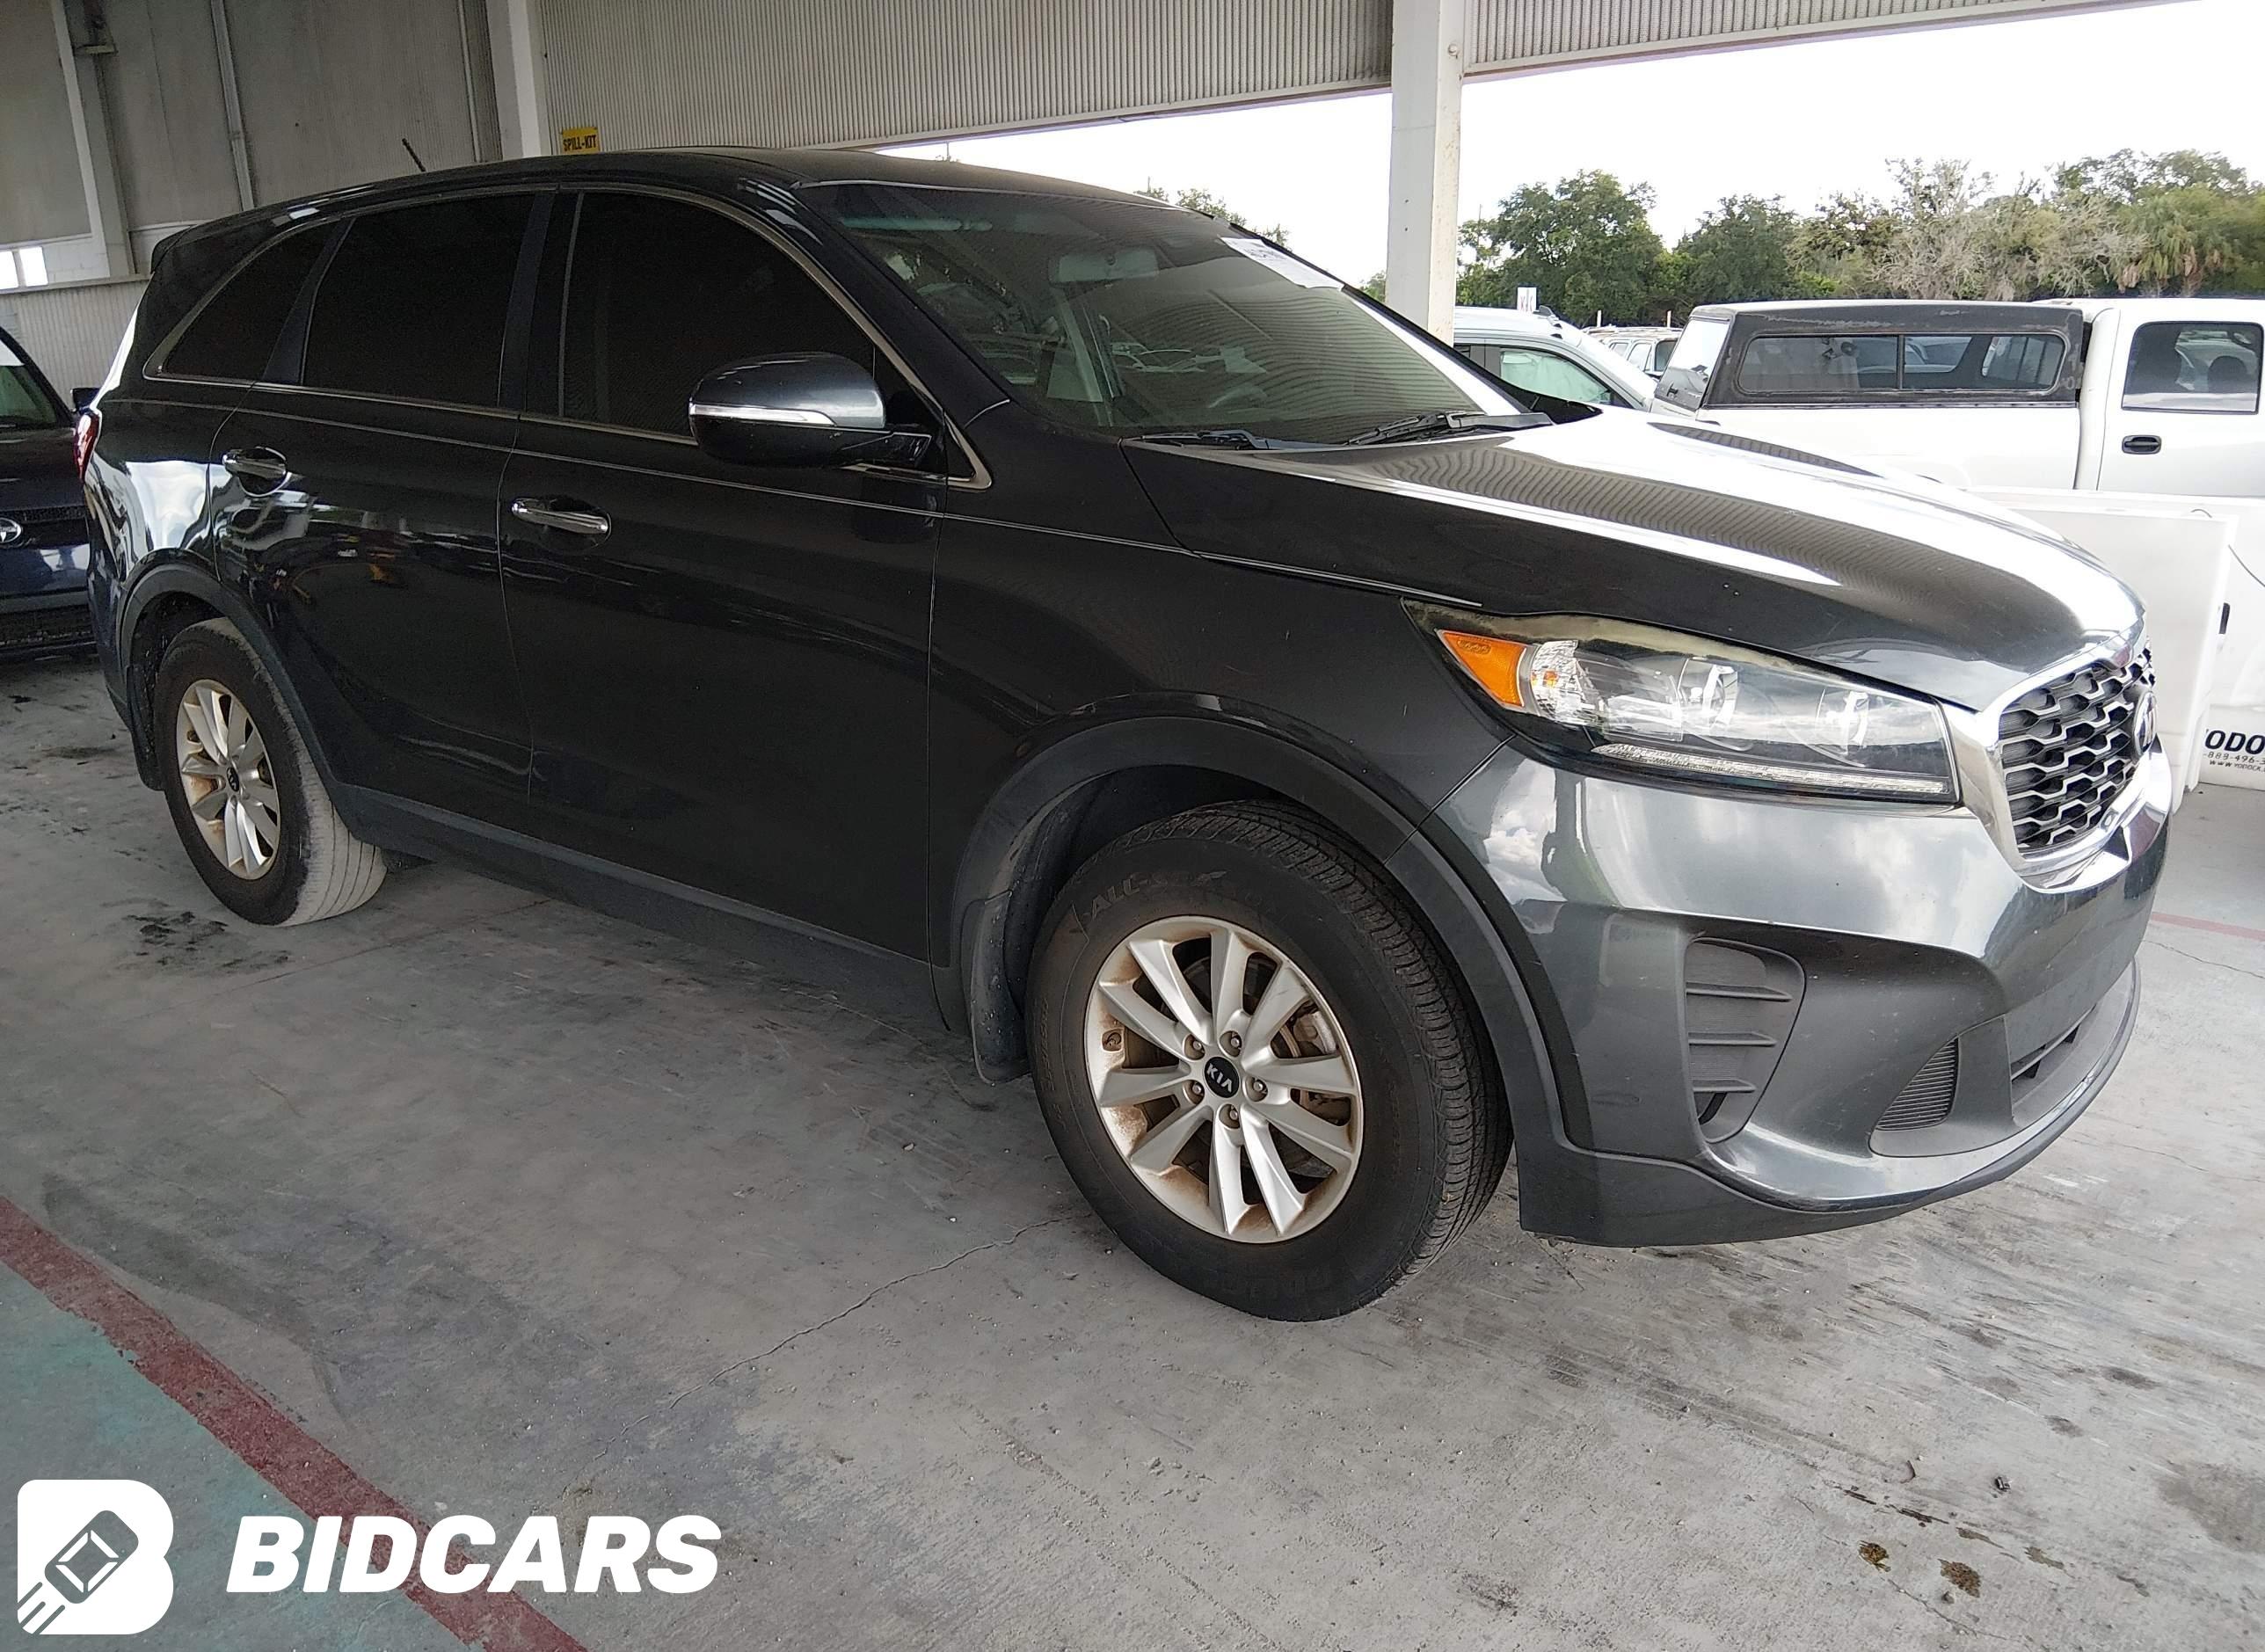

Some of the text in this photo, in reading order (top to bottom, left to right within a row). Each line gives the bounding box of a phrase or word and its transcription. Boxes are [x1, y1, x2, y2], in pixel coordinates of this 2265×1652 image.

[563, 135, 596, 151] SPILL-KIT
[2204, 728, 2265, 755] ODO
[1206, 1062, 1232, 1093] KIA
